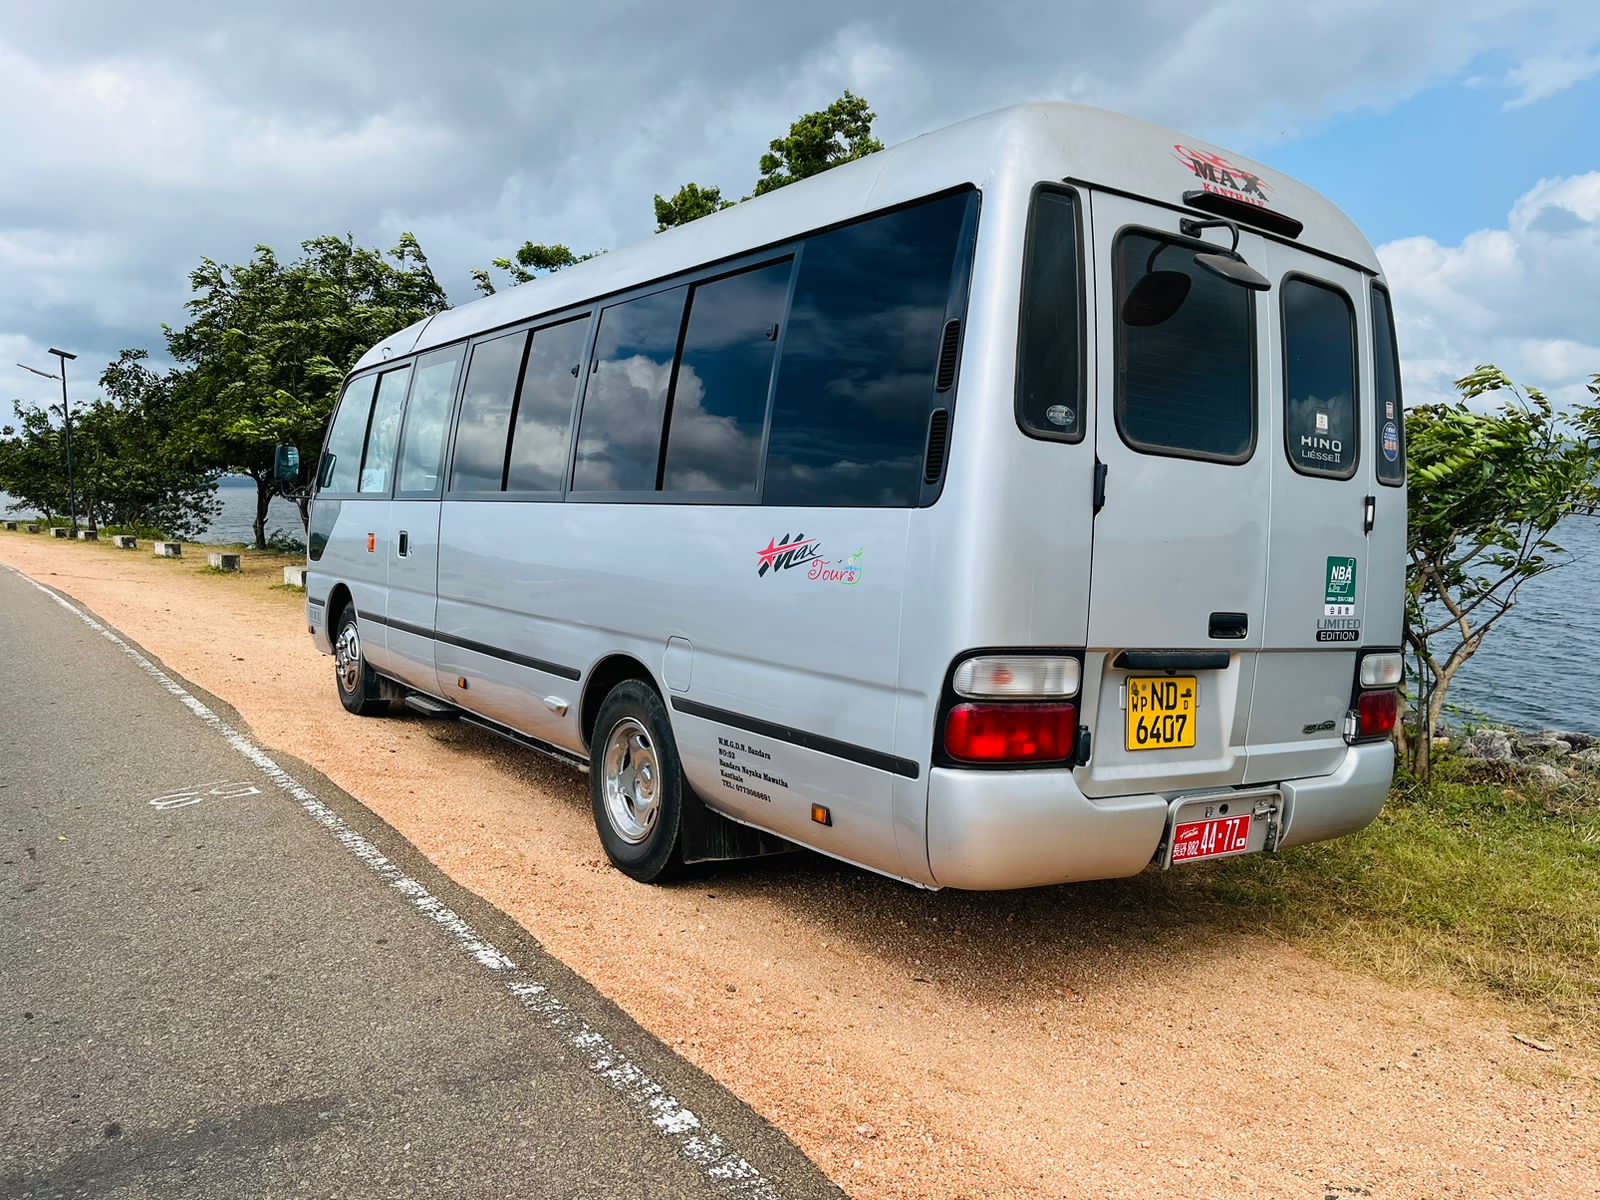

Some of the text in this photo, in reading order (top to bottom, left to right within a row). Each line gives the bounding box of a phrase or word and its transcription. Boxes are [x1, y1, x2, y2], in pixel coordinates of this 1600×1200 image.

[1191, 158, 1269, 202] MAX
[1301, 435, 1342, 453] HINO
[808, 559, 856, 582] Tours
[1331, 566, 1352, 581] NBA
[1317, 619, 1360, 629] LIMITED
[1321, 631, 1355, 641] EDITION
[1136, 714, 1187, 744] 6407
[748, 746, 771, 760] Bandara
